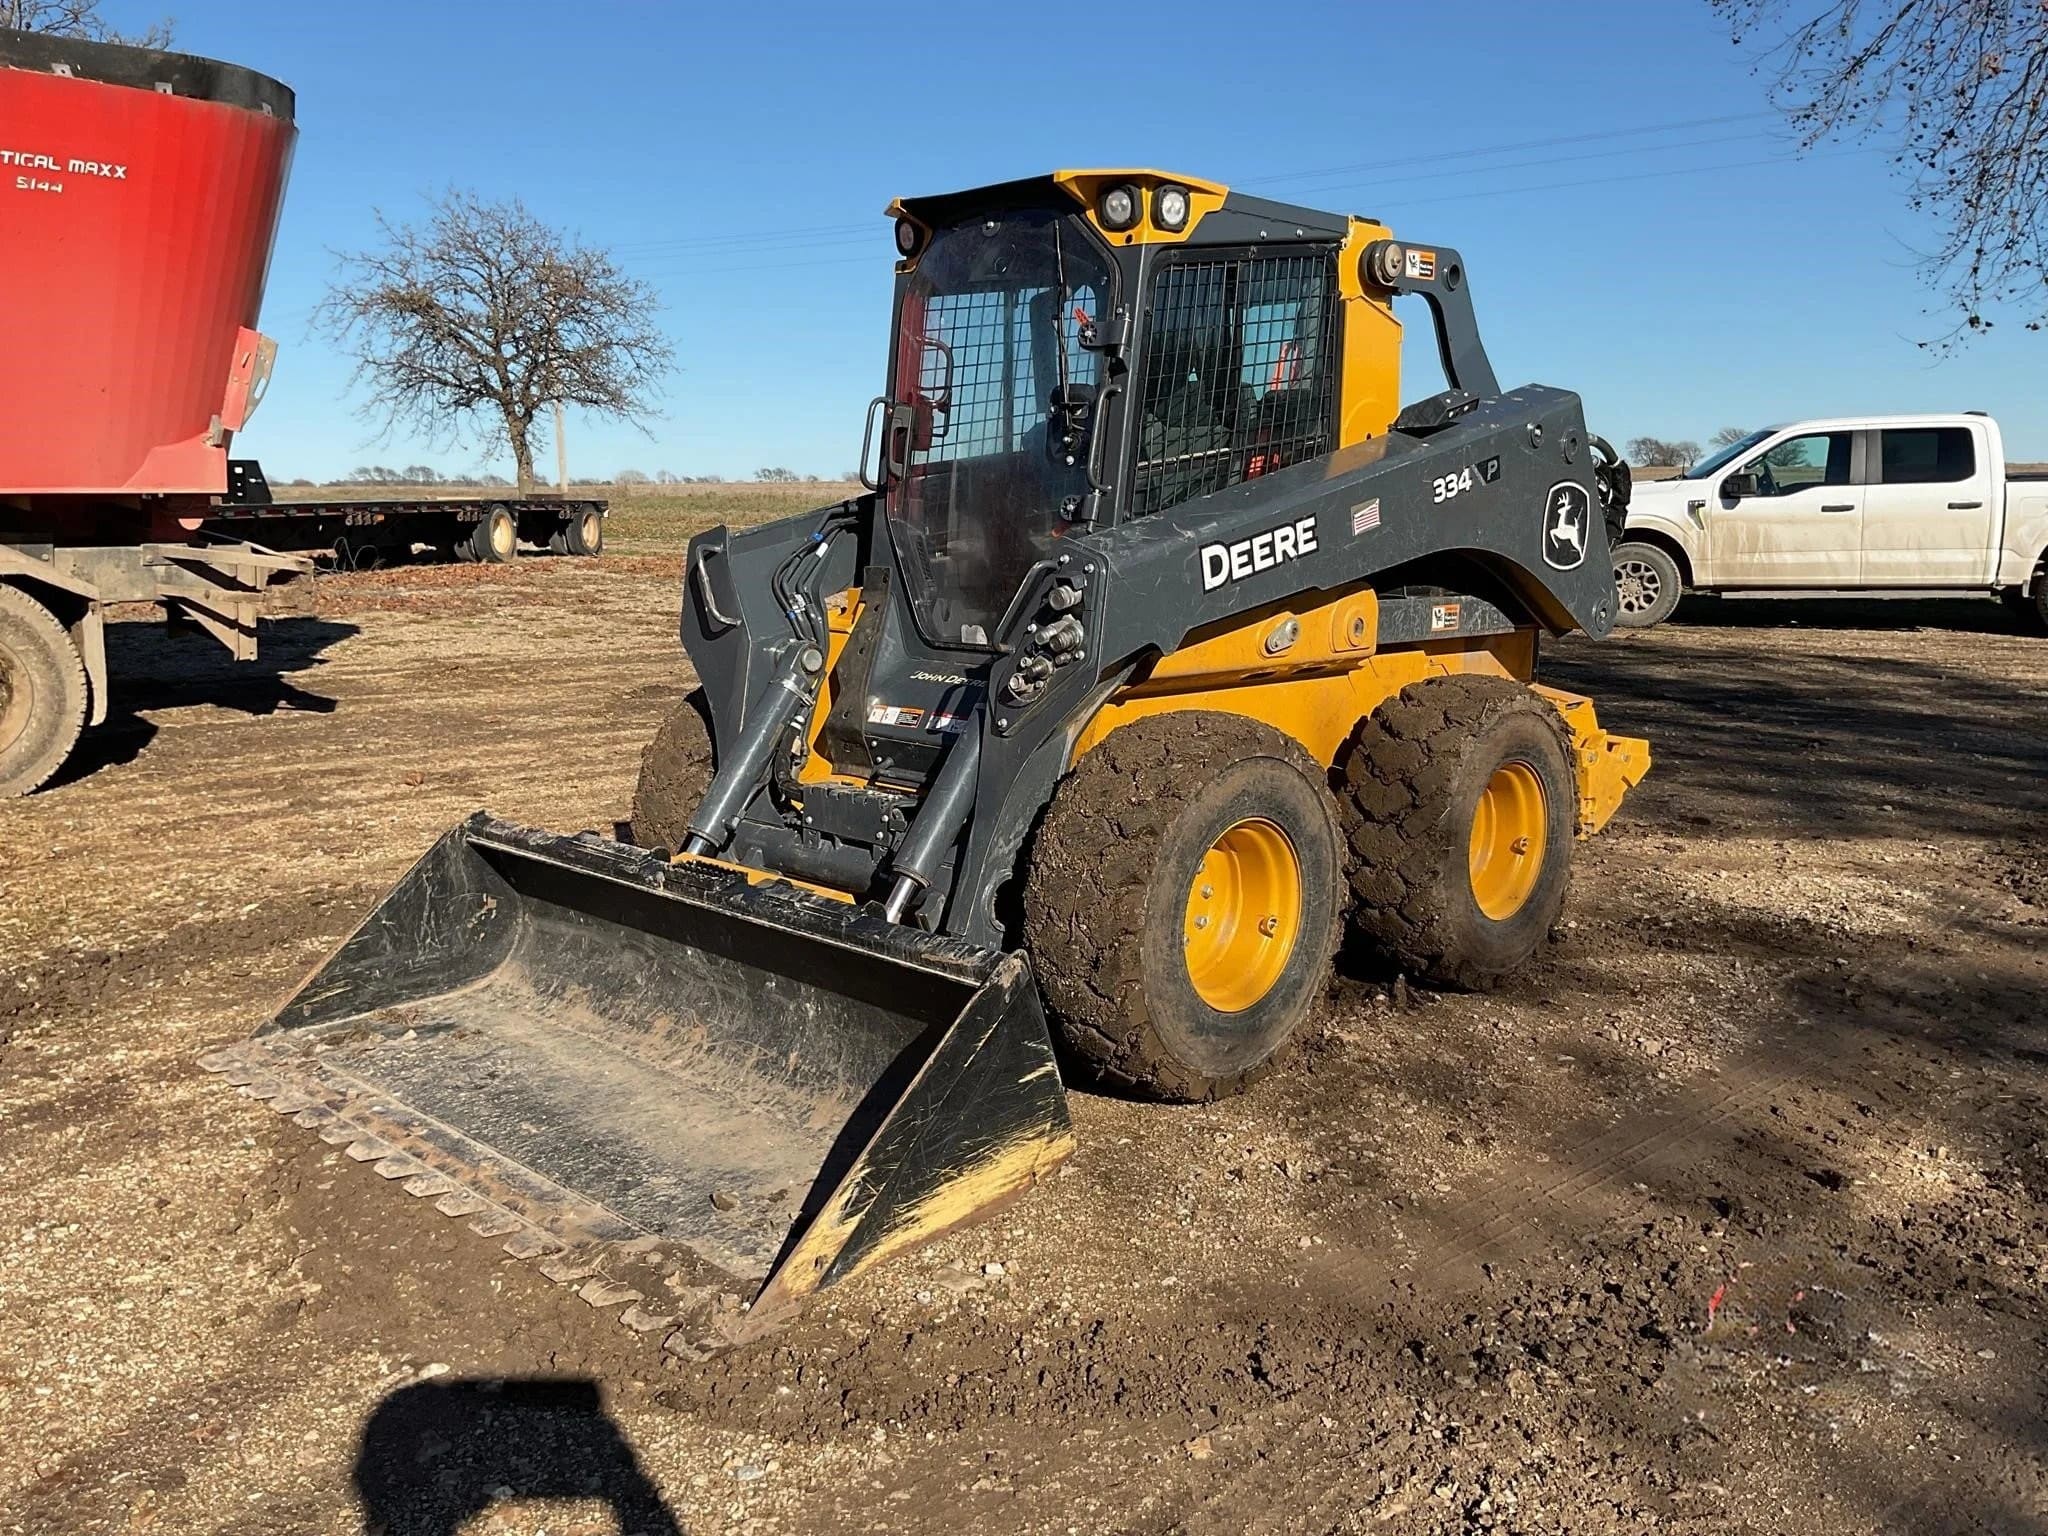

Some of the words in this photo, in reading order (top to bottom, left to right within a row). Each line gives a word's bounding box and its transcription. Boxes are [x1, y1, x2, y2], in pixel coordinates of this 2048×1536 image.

[68, 159, 128, 179] MAXX
[16, 176, 63, 193] 5144
[1432, 468, 1473, 503] 334
[1200, 516, 1318, 592] DEERE
[909, 671, 946, 682] JOHN
